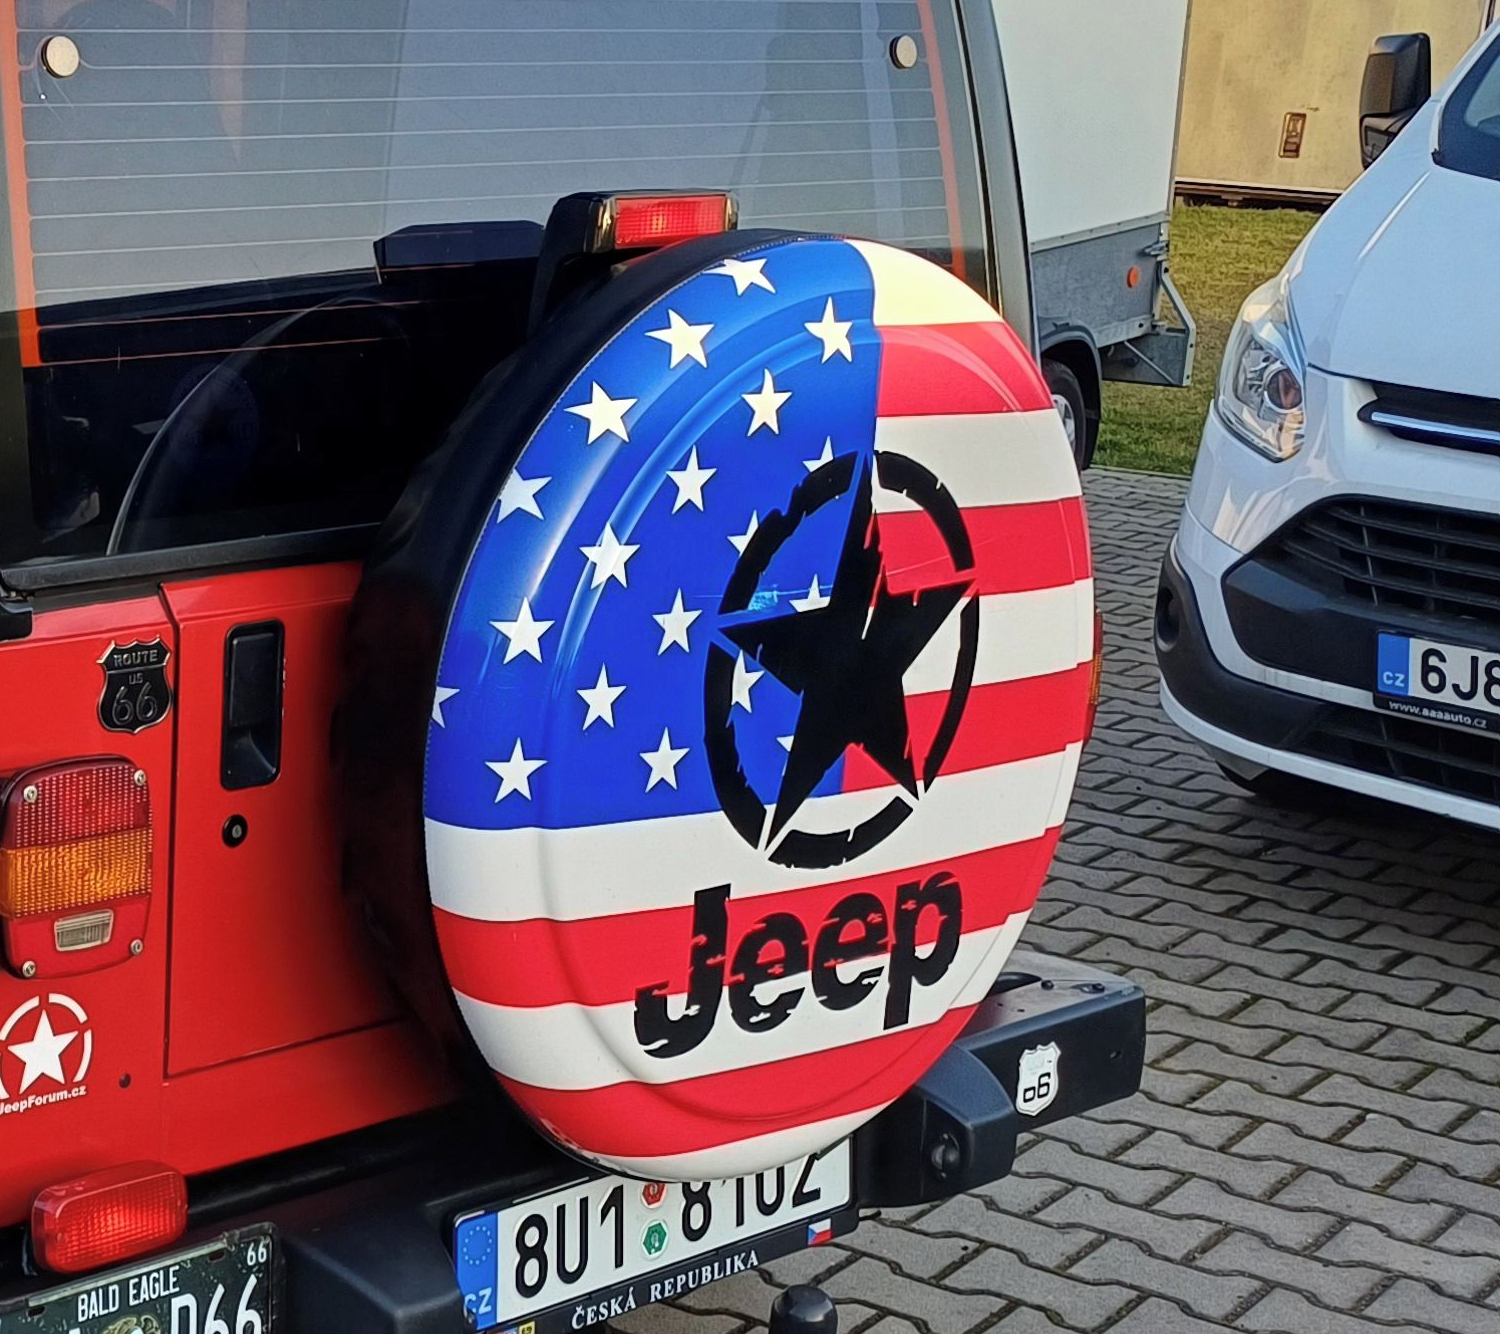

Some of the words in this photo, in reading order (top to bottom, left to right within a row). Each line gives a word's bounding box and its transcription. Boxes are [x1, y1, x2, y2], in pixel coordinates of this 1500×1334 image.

[114, 649, 159, 667] ROUTE
[128, 672, 143, 685] US
[1382, 671, 1405, 687] CZ
[112, 681, 158, 725] 66
[1388, 700, 1488, 729] www.aaaauto.cz
[633, 870, 963, 1059] Jeep
[247, 1240, 267, 1266] 66
[515, 1184, 625, 1298] 8U1
[77, 1283, 120, 1323] BALD
[129, 1265, 180, 1307] EAGLE
[571, 1289, 637, 1330] ČESKÁ
[650, 1249, 760, 1302] REPUBLIKA
